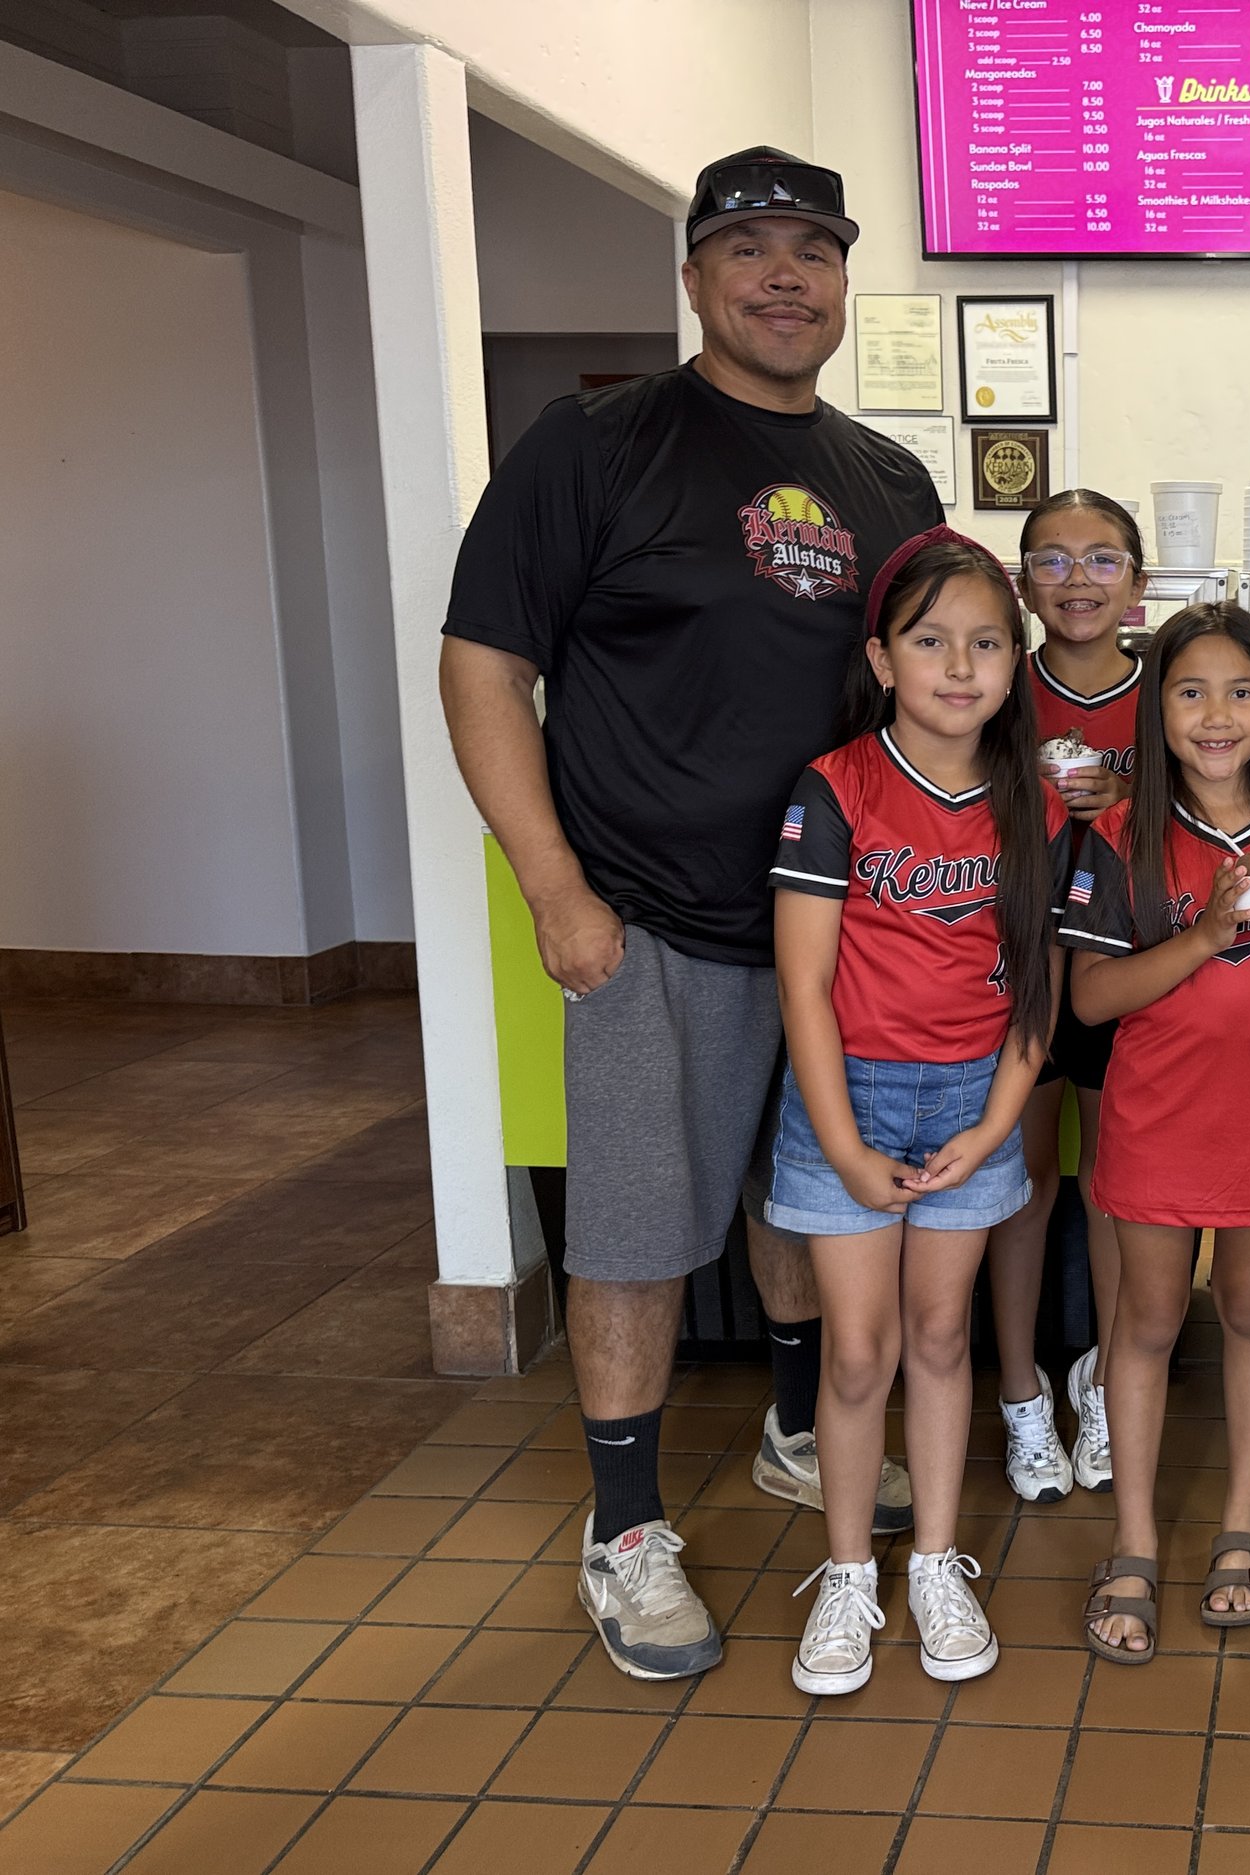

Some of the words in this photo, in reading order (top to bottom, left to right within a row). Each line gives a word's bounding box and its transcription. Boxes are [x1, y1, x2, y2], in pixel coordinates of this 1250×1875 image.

[960, 0, 988, 9] Nieve
[1013, 0, 1047, 9] Cream
[1138, 4, 1150, 14] 32
[968, 14, 973, 24] 1
[974, 16, 998, 25] scoop
[1080, 12, 1102, 23] 4.00
[968, 28, 974, 38] 2
[975, 30, 1000, 39] scoop
[1080, 29, 1102, 39] 6.50
[1134, 22, 1196, 34] Chamoyada
[968, 42, 974, 51] 3
[975, 44, 1000, 53] scoop
[1080, 43, 1102, 53] 8.50
[1140, 39, 1151, 49] 16
[977, 56, 991, 65] add
[991, 57, 1017, 66] scoop
[1052, 57, 1071, 66] 2.50
[1138, 53, 1150, 62] 32
[965, 69, 1037, 80] Mangoneadas
[972, 82, 978, 92] 2
[979, 84, 1003, 94] scoop
[1083, 81, 1103, 91] 7.00
[972, 97, 978, 106] 3
[979, 98, 1004, 107] scoop
[1082, 97, 1104, 107] 8.50
[972, 110, 979, 120] 4
[979, 112, 1004, 121] scoop
[1083, 111, 1104, 121] 9.50
[1136, 115, 1165, 127] Jugos
[1167, 115, 1215, 126] Naturales
[1224, 115, 1250, 125] Fresh
[973, 124, 979, 133] 5
[980, 125, 1005, 135] scoop
[1083, 125, 1108, 135] 10.50
[1143, 132, 1153, 141] 16
[969, 144, 1009, 154] Banana
[1010, 143, 1031, 157] Split
[1082, 144, 1109, 154] 10.00
[1137, 150, 1169, 162] Aguas
[1170, 150, 1206, 160] Frescas
[970, 162, 1007, 172] Sundae
[1008, 162, 1032, 172] Bowl
[1083, 162, 1109, 172] 10.00
[1144, 166, 1154, 175] 16
[971, 179, 1020, 191] Raspados
[1144, 180, 1155, 189] 32
[977, 195, 988, 204] 12
[1085, 195, 1107, 204] 5.50
[1137, 195, 1188, 206] Smoothies
[1190, 195, 1199, 206] &
[977, 208, 988, 218] 16
[1086, 208, 1108, 218] 6.50
[1145, 209, 1155, 219] 16
[977, 222, 988, 232] 32
[1087, 222, 1111, 232] 10.00
[1144, 223, 1156, 233] 32
[888, 434, 919, 443] OTICE
[985, 460, 1033, 474] KERMAN
[741, 507, 859, 561] Kerman
[772, 543, 842, 575] Allstars
[856, 846, 1002, 909] Kerm
[622, 1528, 645, 1547] NIKE
